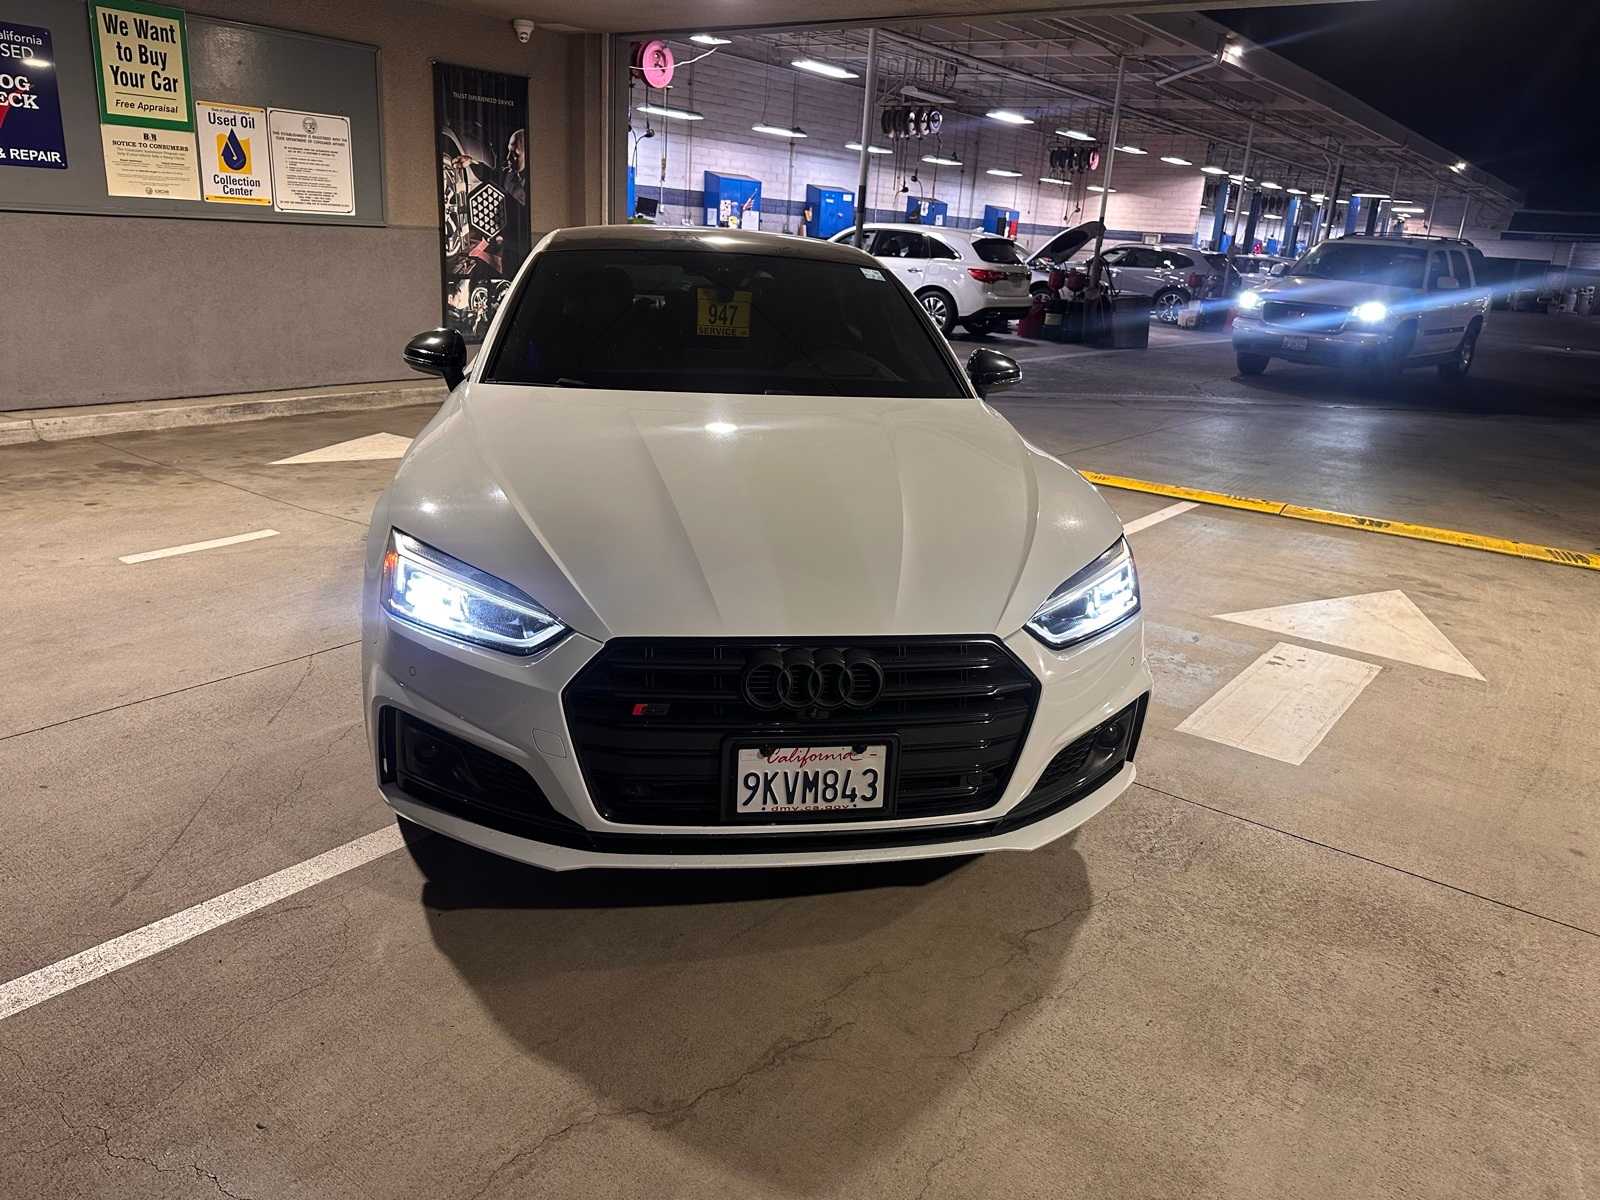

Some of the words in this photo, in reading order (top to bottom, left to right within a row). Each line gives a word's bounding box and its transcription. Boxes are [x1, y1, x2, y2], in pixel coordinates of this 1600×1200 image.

[102, 12, 129, 36] We
[133, 17, 177, 44] Want
[0, 43, 34, 59] SED
[115, 41, 132, 62] to
[138, 44, 167, 71] Buy
[0, 73, 30, 91] OG
[109, 64, 145, 89] Your
[151, 70, 178, 93] Car
[115, 99, 135, 108] Free
[137, 101, 178, 113] Appraisal
[207, 111, 237, 127] Used
[240, 115, 255, 129] Oil
[112, 140, 137, 148] NOTICE
[149, 143, 189, 152] CONSUMERS
[9, 148, 62, 163] REPAIR
[213, 174, 261, 187] Collection
[222, 184, 253, 196] Center
[708, 303, 738, 326] 947
[766, 747, 862, 768] California
[742, 768, 879, 806] 9KVM843
